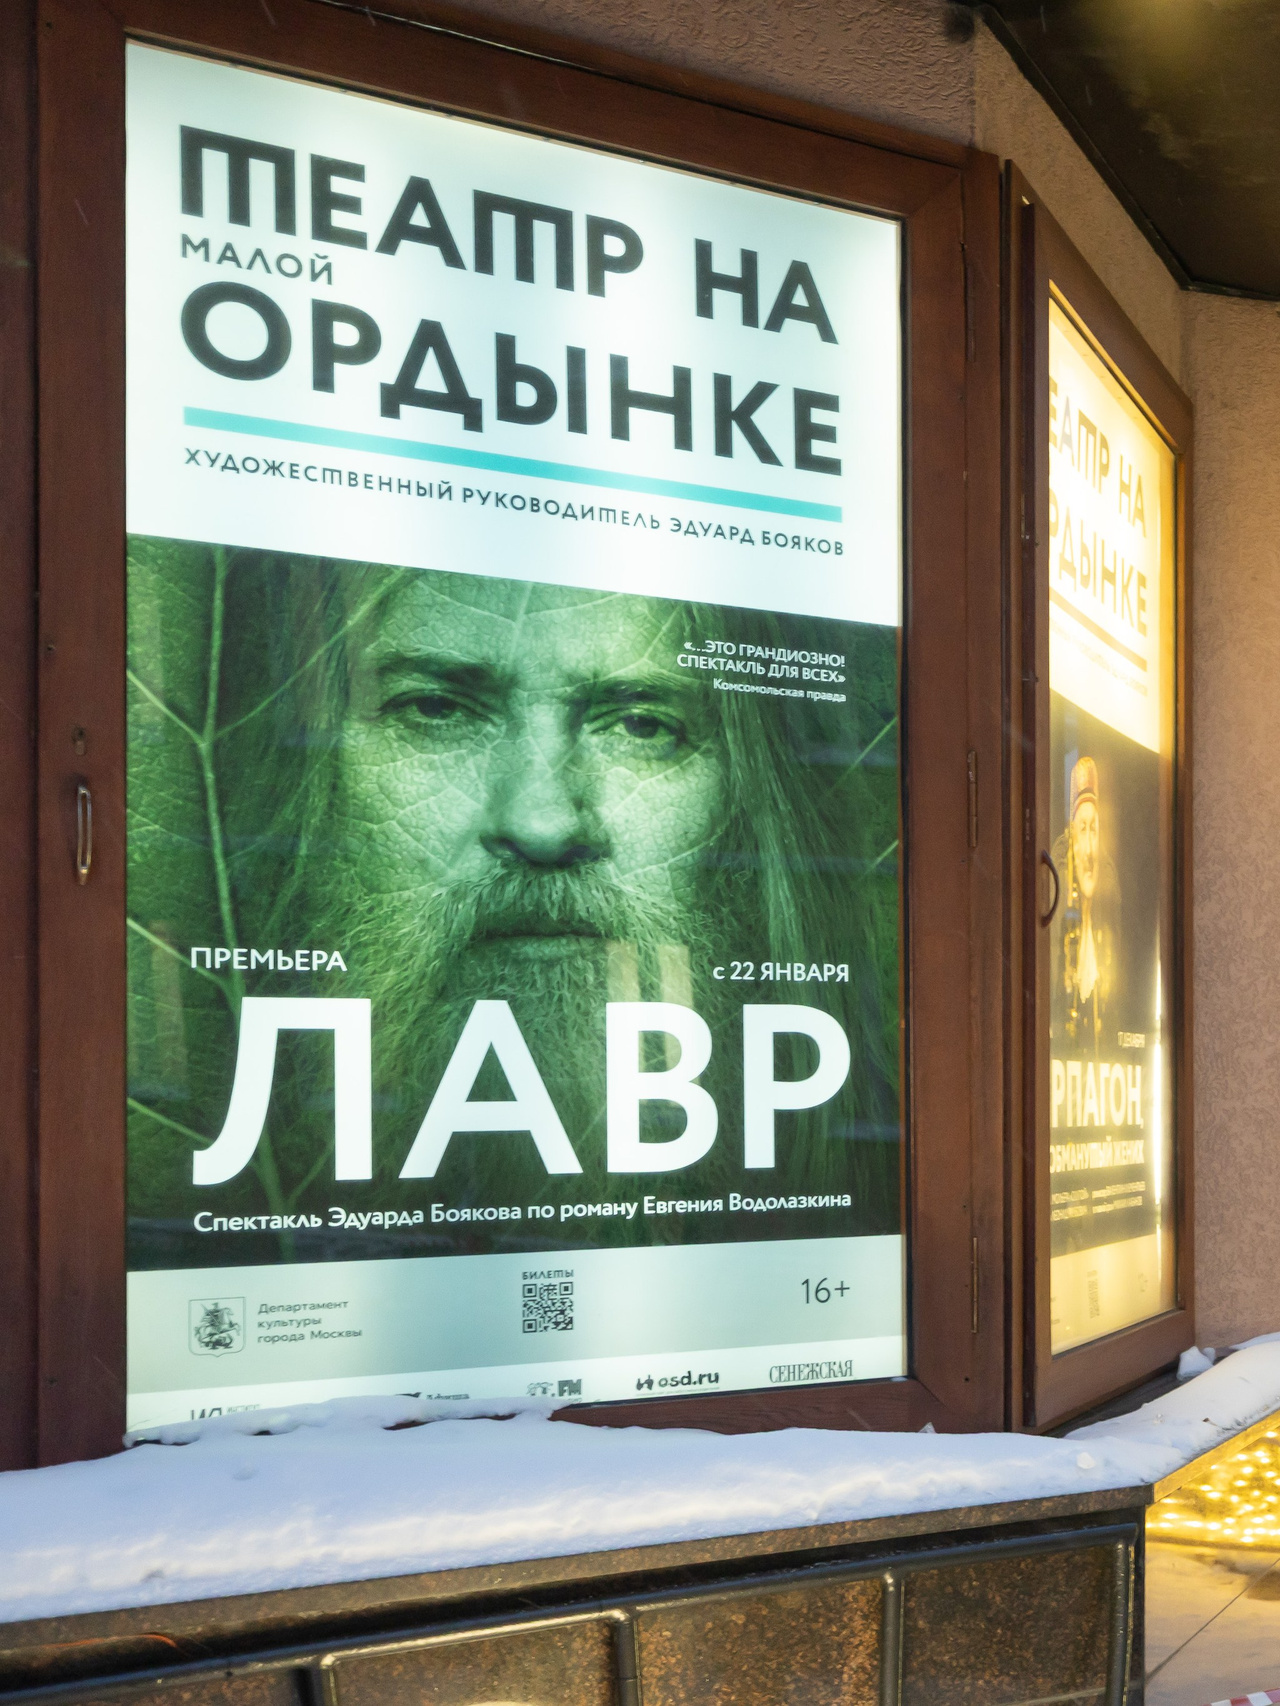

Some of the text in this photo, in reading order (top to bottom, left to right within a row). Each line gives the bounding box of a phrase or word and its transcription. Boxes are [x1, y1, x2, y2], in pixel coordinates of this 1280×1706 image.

[179, 125, 839, 345] ТЕАТР НА
[181, 233, 333, 286] МАЛОЙ
[181, 281, 842, 477] ОРДЫНКЕ
[185, 448, 843, 555] ХУДОЖЕСТВЕННЫЙ РУКОВОДИТЕЛЬ ЭДУАРД БОЯКОВ
[1119, 454, 1146, 538] НА
[677, 654, 846, 683] СПЕКТАКЛЬ ДЛЯ ВСЕХ»
[739, 645, 845, 667] ГРАНДИОЗНО!
[713, 678, 846, 702] Комсомольская правда
[190, 947, 347, 972] ПРЕМЬЕРА
[730, 961, 754, 981] 22
[759, 961, 849, 982] ЯНВАРЯ
[193, 996, 851, 1185] ЛАВР
[194, 1193, 851, 1232] Спектакль Эдуарда Боякова по роману Евгения Водолазкина
[522, 1269, 574, 1280] БИЛЕТЫ
[801, 1277, 850, 1304] 16+
[258, 1300, 349, 1315] Департамент
[258, 1316, 322, 1329] культуры
[257, 1328, 362, 1344] города Москвы
[769, 1360, 853, 1384] СЕНЕЖСКАЯ
